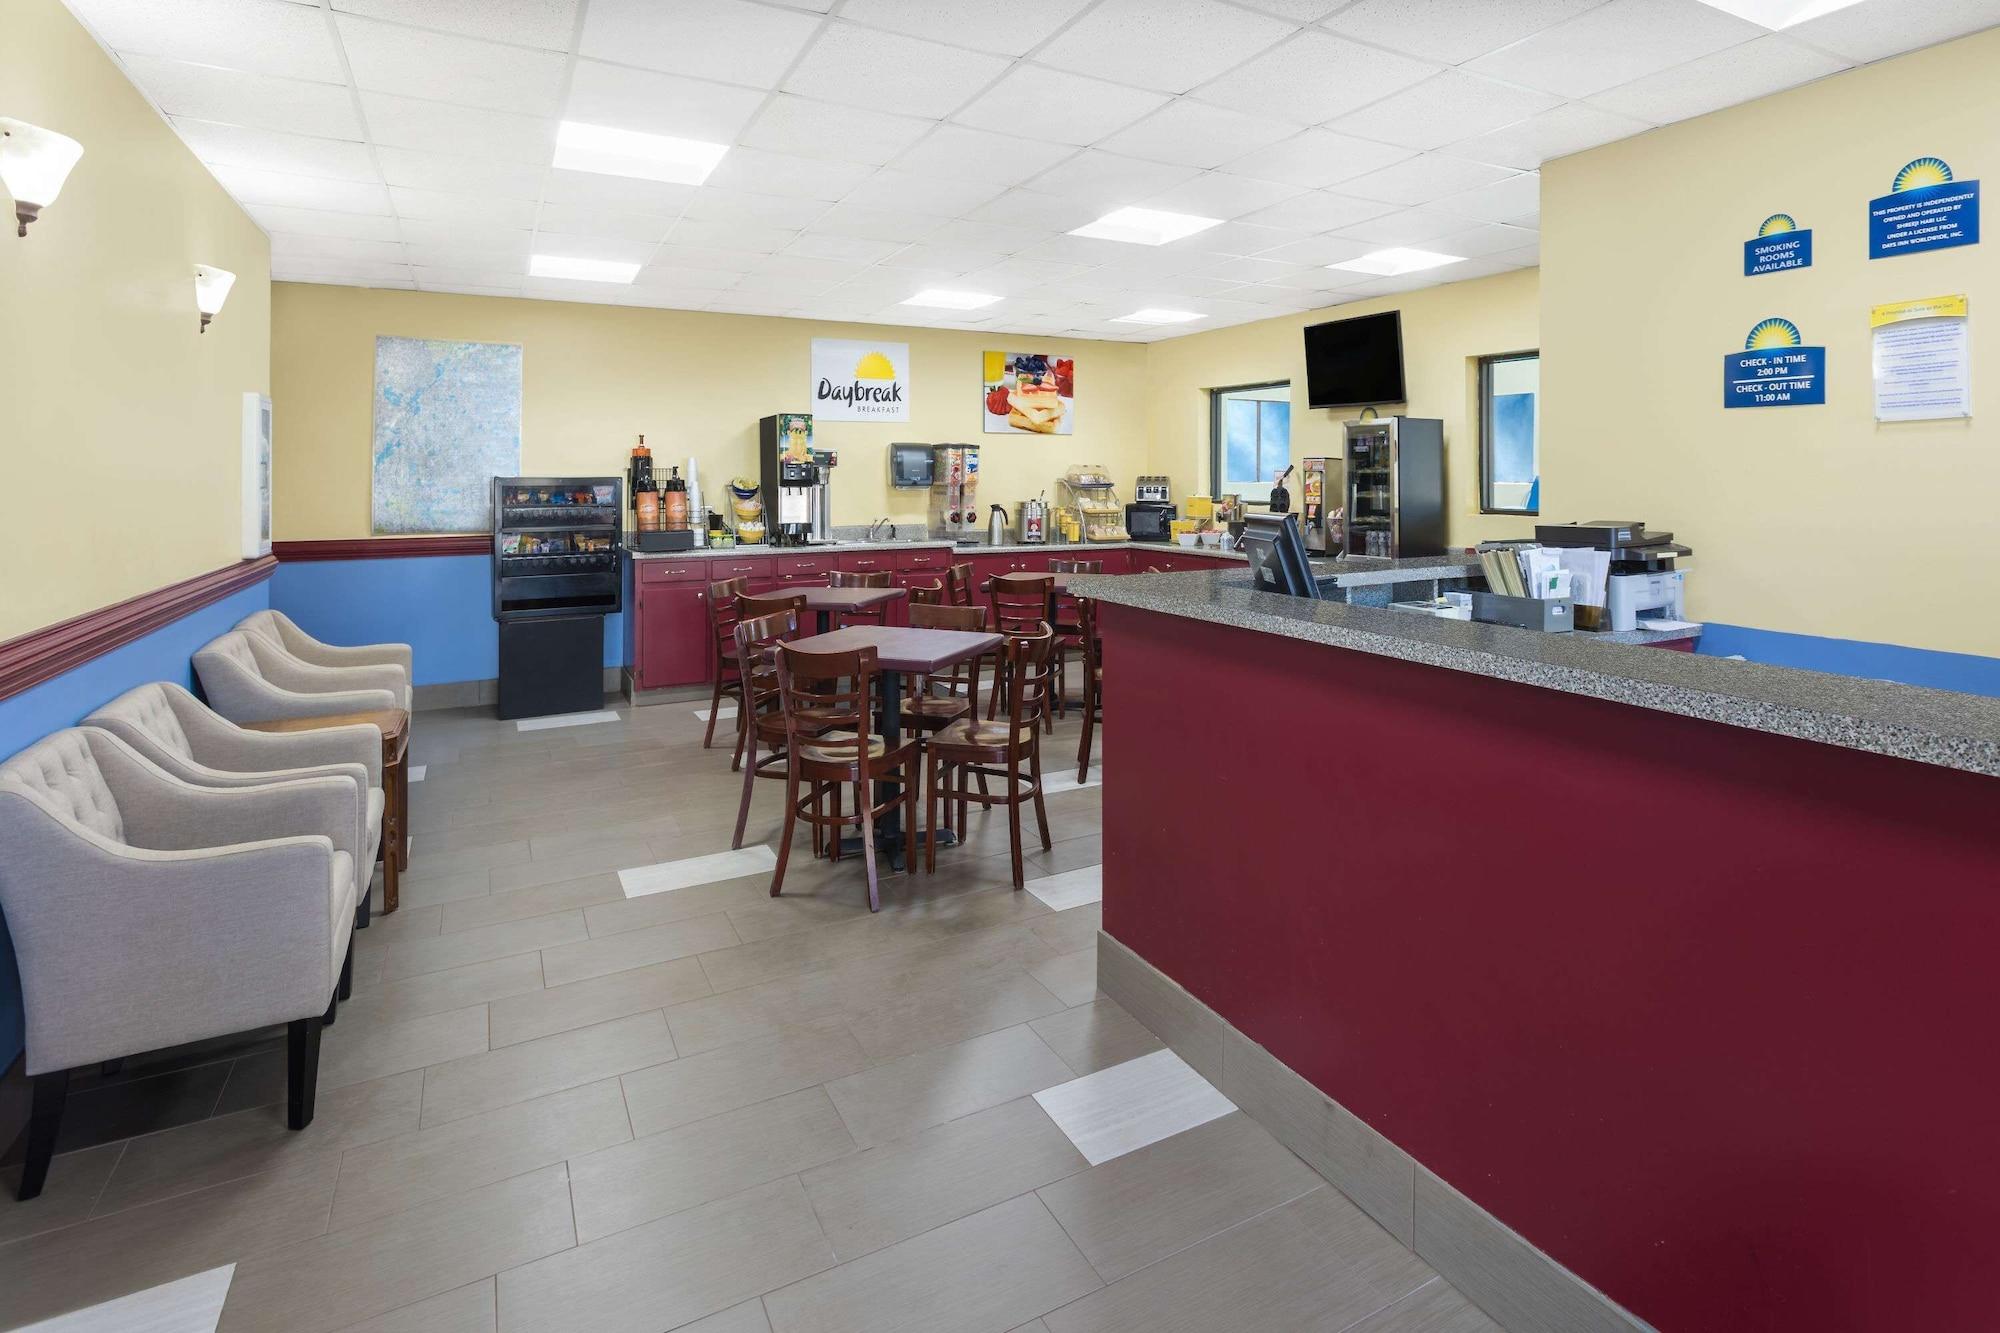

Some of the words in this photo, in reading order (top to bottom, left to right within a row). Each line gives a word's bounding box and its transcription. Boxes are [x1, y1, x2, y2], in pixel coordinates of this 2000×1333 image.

[1887, 203, 1916, 214] PROPERTY
[1923, 193, 1974, 207] INDEPENDENTLY
[1883, 214, 1906, 223] OWNED
[1921, 206, 1952, 216] OPERATED
[1887, 231, 1907, 239] UNDER
[1914, 226, 1938, 235] LICENSE
[1910, 233, 1949, 244] WORLDWIDE,
[1755, 241, 1800, 255] SMOKING
[1760, 250, 1794, 263] ROOMS
[1753, 258, 1803, 272] AVAILABLE
[1740, 358, 1767, 367] CHECK
[1784, 354, 1807, 363] TIME
[1757, 368, 1773, 376] 2:00
[818, 378, 901, 408] Daybreak
[1736, 384, 1763, 393] CHECK
[1769, 382, 1788, 391] OUT
[1789, 381, 1811, 389] TIME
[1755, 393, 1775, 402] 11:00
[1776, 393, 1790, 401] AM
